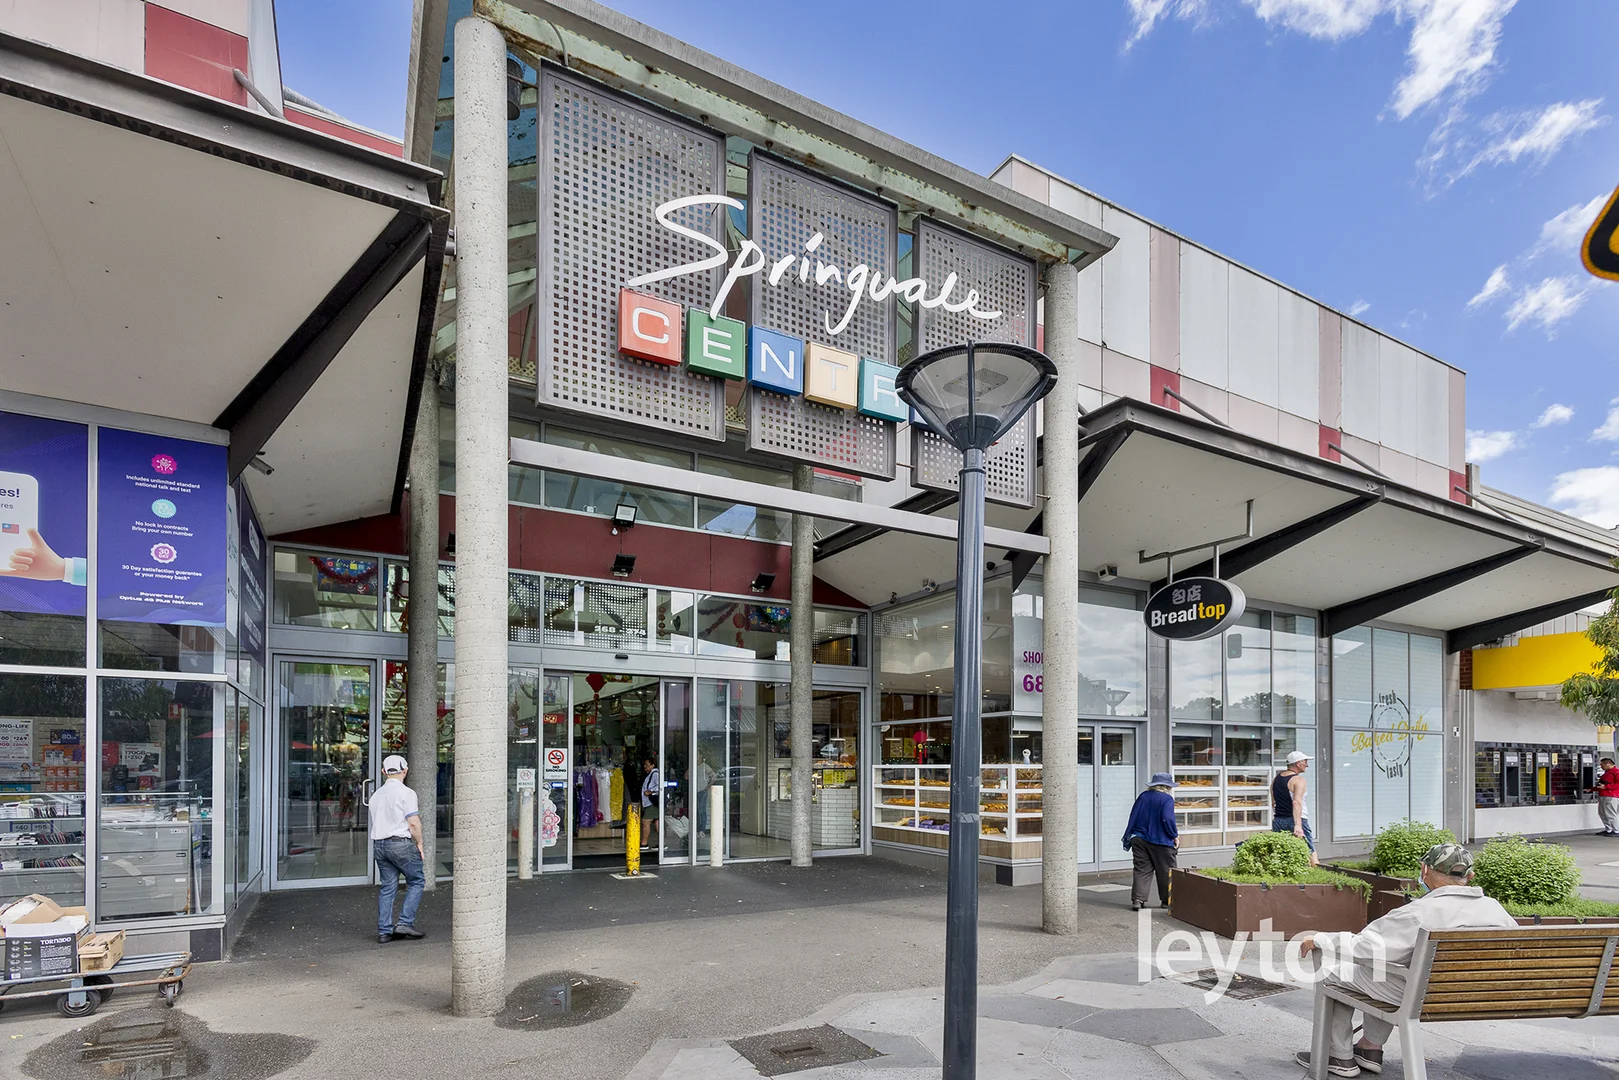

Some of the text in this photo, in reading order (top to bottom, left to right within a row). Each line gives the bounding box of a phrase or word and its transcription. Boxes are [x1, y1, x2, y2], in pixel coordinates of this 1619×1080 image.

[628, 194, 1002, 335] Springvale
[632, 306, 901, 410] CENTR
[126, 474, 200, 489] Includes unlimited standard
[0, 488, 20, 498] es!
[158, 547, 170, 555] 30
[140, 591, 173, 599] Powered
[1022, 673, 1043, 693] 68
